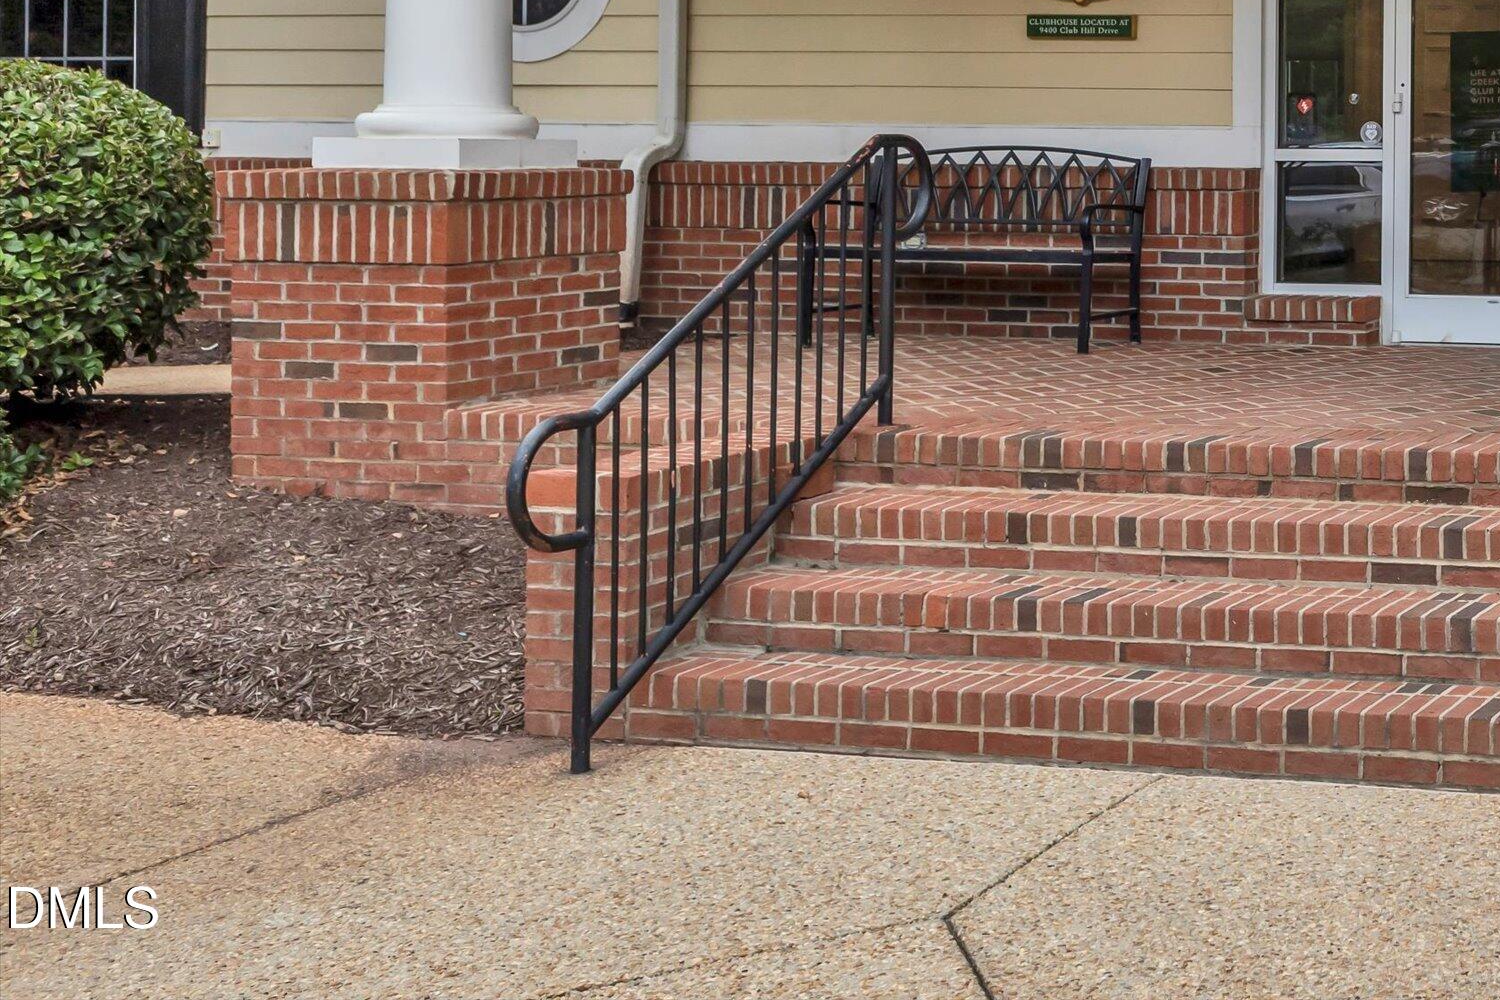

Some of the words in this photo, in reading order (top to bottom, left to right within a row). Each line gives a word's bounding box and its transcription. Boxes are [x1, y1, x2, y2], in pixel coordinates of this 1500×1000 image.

[1029, 18, 1078, 26] CLUBHOUSE
[1080, 18, 1117, 26] LOCATED
[1119, 18, 1130, 26] AT
[1470, 69, 1487, 77] LIFE
[1470, 78, 1500, 86] CREEK
[1471, 96, 1494, 104] WITH
